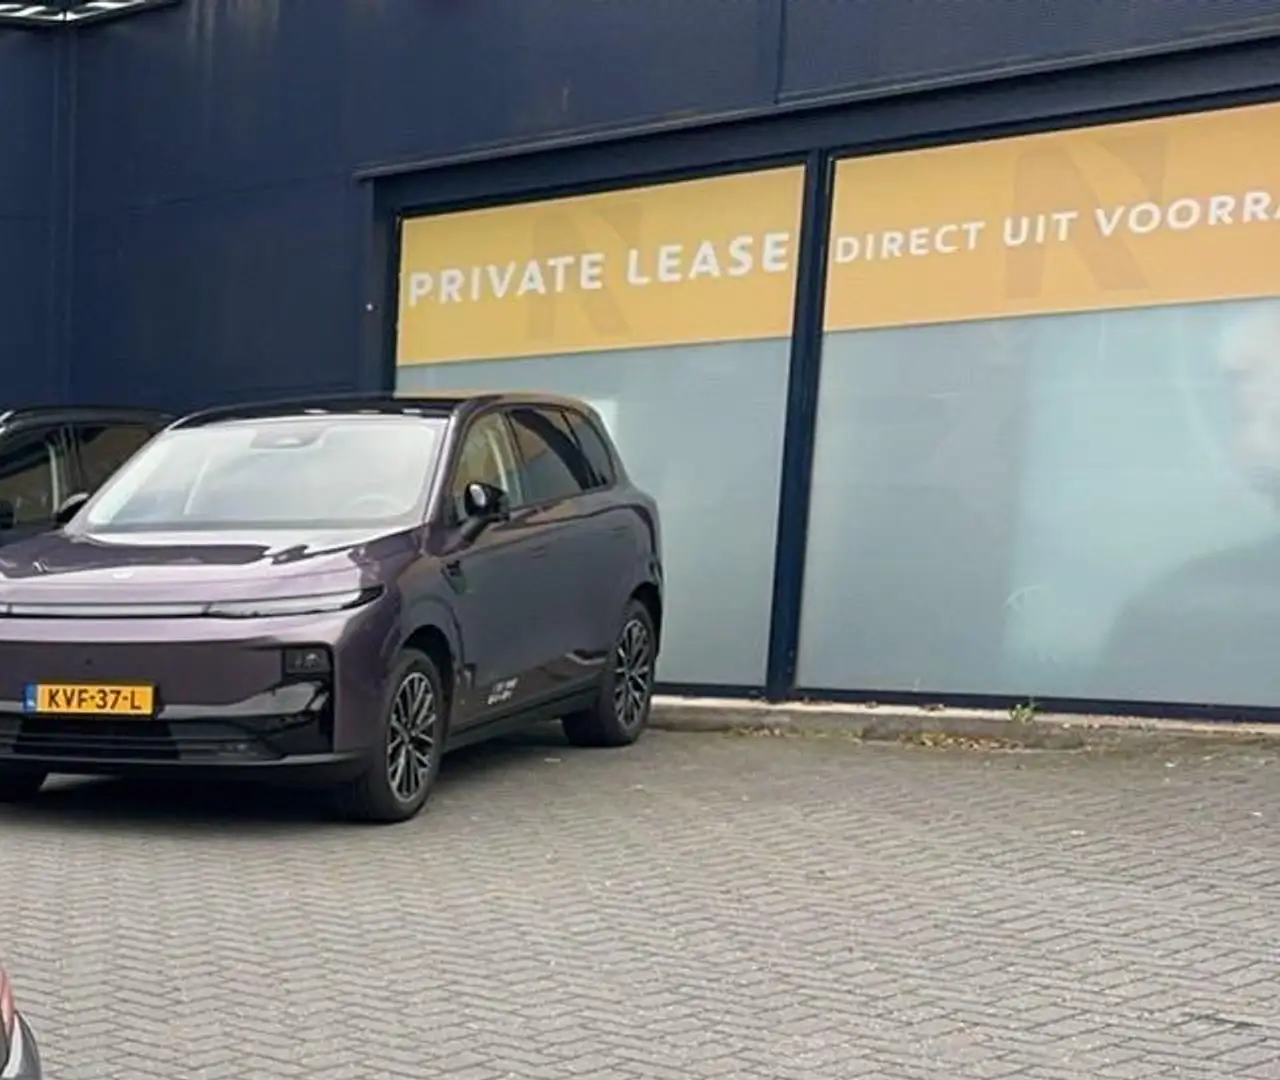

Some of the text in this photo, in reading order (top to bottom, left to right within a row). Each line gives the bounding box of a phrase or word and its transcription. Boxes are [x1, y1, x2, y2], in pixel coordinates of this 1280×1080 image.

[834, 191, 1280, 264] DIRECT UIT VOORR
[408, 232, 790, 307] PRIVATE LEASE
[47, 688, 143, 710] KVF-37-L
